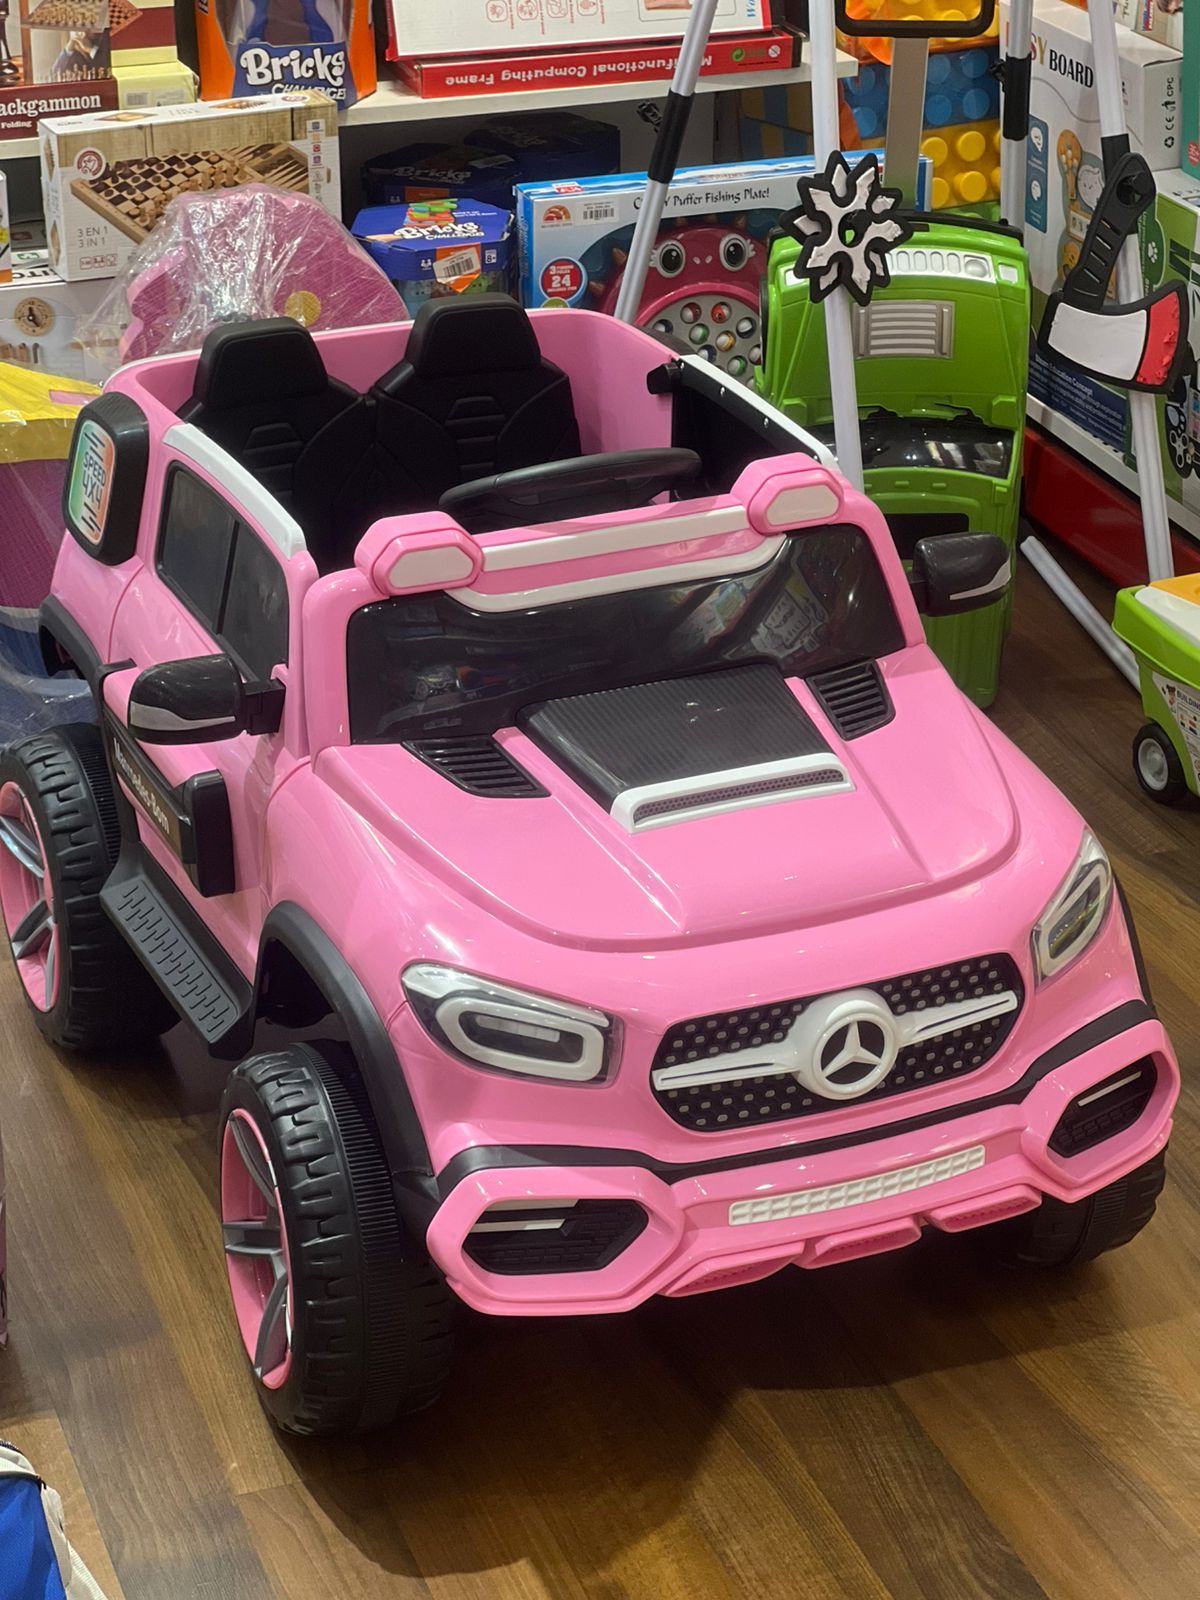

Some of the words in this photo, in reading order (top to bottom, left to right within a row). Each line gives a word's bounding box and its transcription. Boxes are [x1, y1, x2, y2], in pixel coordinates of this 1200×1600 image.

[240, 48, 345, 87] Bricks
[501, 66, 587, 82] Computing
[592, 56, 712, 76] Mifunctional
[1049, 49, 1094, 88] BOARD
[445, 73, 494, 86] Frame
[0, 94, 102, 117] ackgammon
[1, 120, 33, 130] Folding
[673, 192, 703, 205] Puffer
[705, 190, 741, 205] Fishing
[744, 187, 770, 200] Plate!
[86, 227, 100, 237] EN
[394, 221, 478, 239] Bricks
[87, 237, 98, 247] IN
[552, 274, 571, 288] 24
[83, 451, 106, 487] SPEED
[83, 469, 103, 510] 4X4
